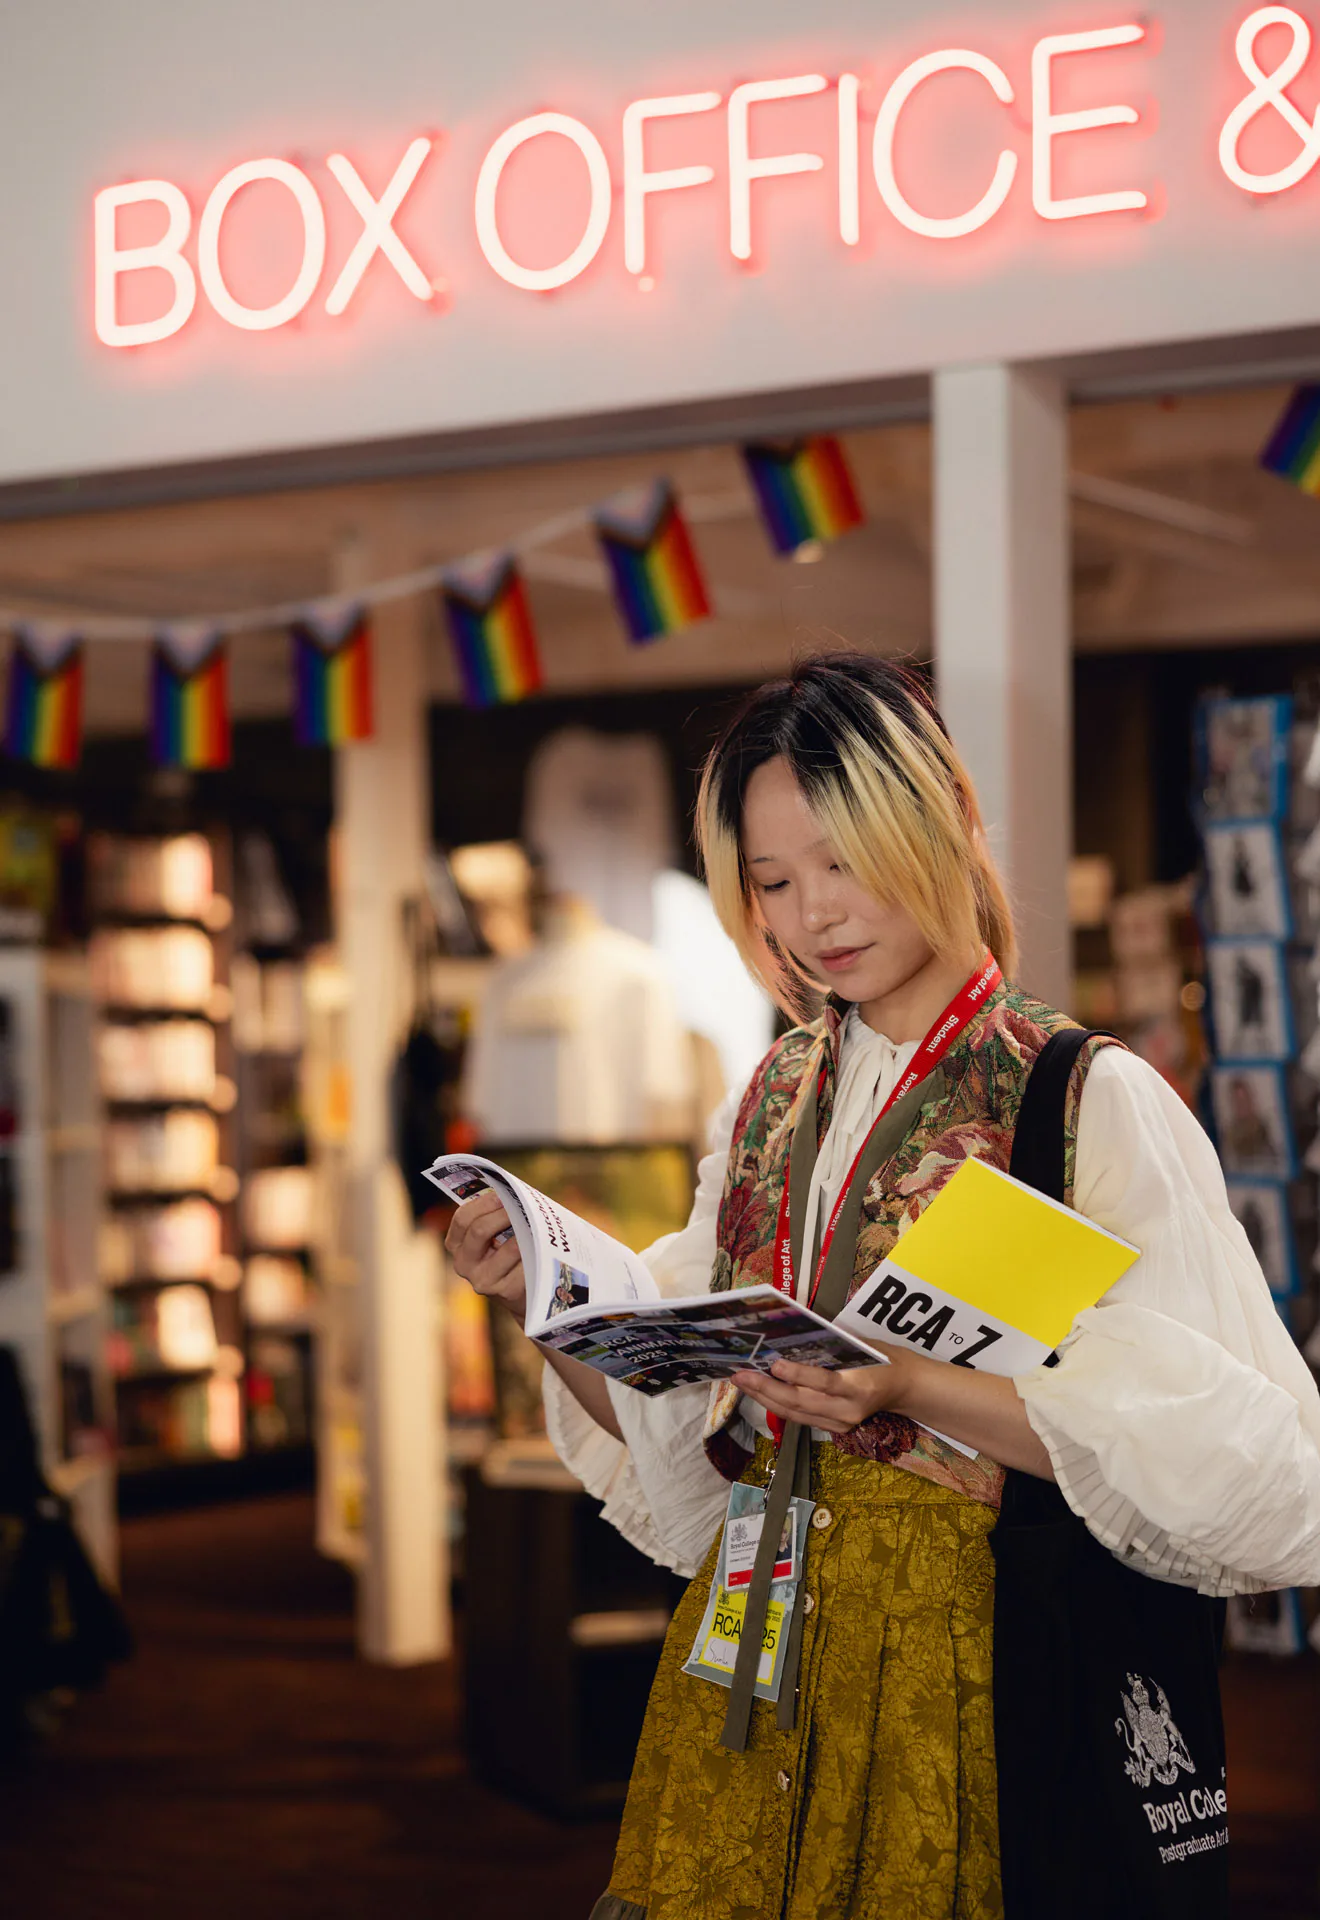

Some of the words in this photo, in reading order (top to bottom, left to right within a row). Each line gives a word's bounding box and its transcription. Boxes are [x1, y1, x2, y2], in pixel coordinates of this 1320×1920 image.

[95, 138, 432, 347] BOX
[475, 24, 1147, 291] OFFICE
[1219, 5, 1320, 194] &
[967, 985, 982, 1001] Art
[925, 1014, 960, 1053] Student
[781, 1238, 791, 1254] Art
[780, 1255, 791, 1267] of
[857, 1274, 956, 1352] RCA
[600, 1334, 640, 1349] RCA
[616, 1339, 706, 1356] ANIMATION
[948, 1332, 964, 1345] TO
[949, 1324, 1003, 1370] Z
[628, 1349, 668, 1364] 2025
[712, 1612, 741, 1640] RCA
[1142, 1791, 1192, 1834] Royal
[1158, 1833, 1217, 1864] Postgraduate
